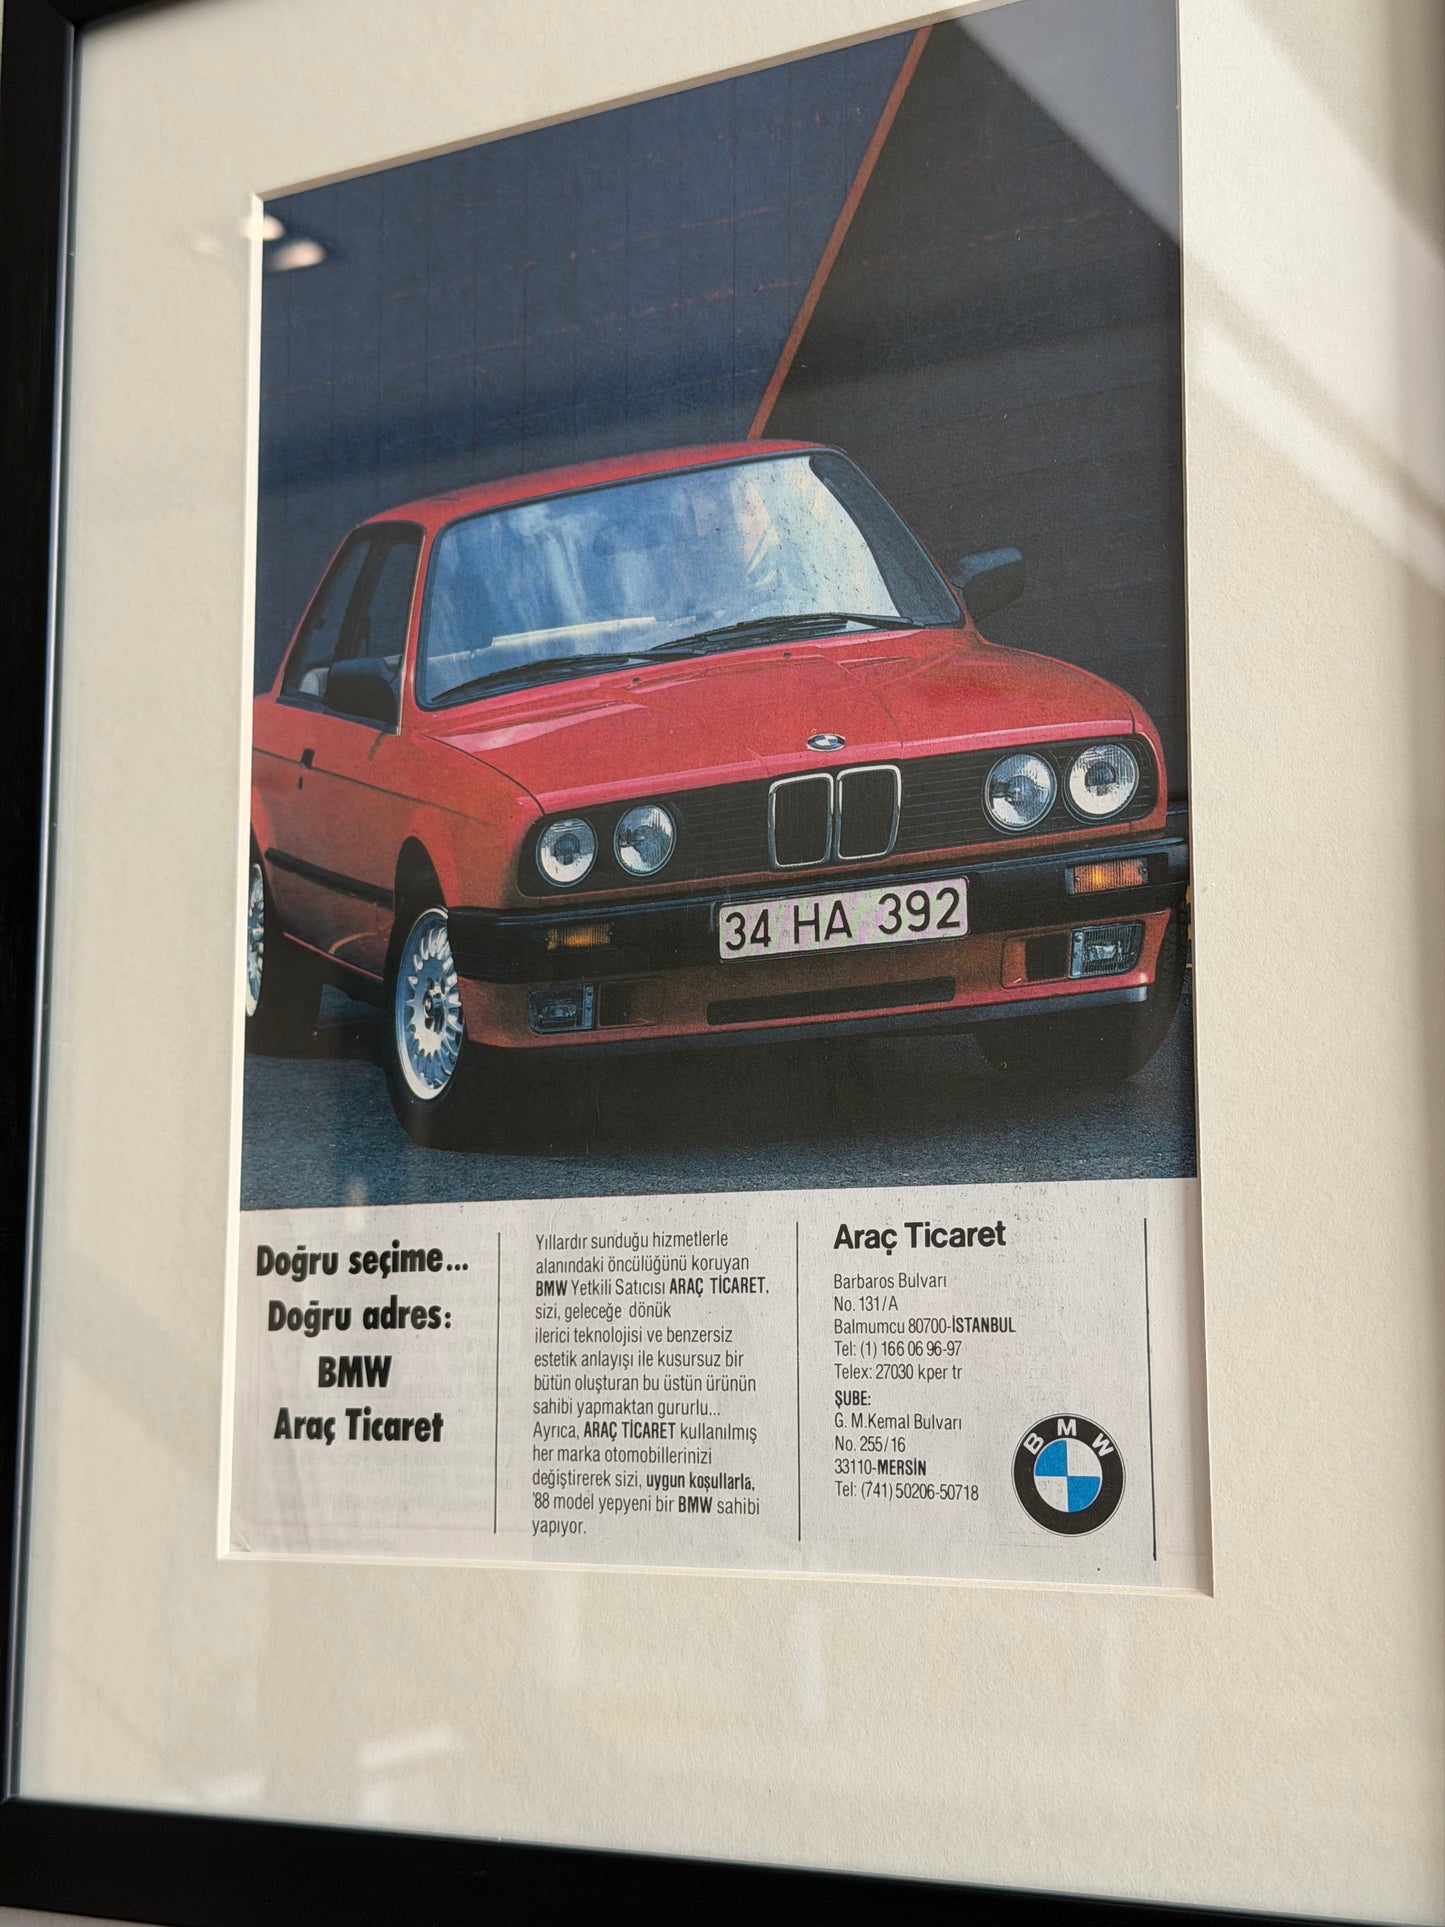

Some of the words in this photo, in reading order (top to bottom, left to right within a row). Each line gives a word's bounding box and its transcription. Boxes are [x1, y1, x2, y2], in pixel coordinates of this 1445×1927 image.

[724, 908, 772, 951] 34
[793, 901, 852, 943] HA
[878, 886, 961, 935] 392
[536, 1234, 587, 1250] Yıllardır
[591, 1233, 649, 1251] sunduğu
[652, 1230, 728, 1248] hizmetlerle
[833, 1224, 898, 1256] Araç
[904, 1220, 1007, 1248] Ticaret
[256, 1245, 339, 1282] Doğru
[348, 1239, 469, 1279] seçime...
[536, 1257, 604, 1274] alanındaki
[608, 1255, 687, 1275] öncülüğünü
[692, 1256, 749, 1274] koruyan
[536, 1280, 568, 1296] BMW
[571, 1279, 612, 1296] Yetkili
[615, 1279, 665, 1295] Satıcısı
[669, 1278, 704, 1297] ARAÇ
[710, 1275, 769, 1295] TİCARET,
[834, 1273, 894, 1289] Barbaros
[898, 1272, 947, 1288] Bulvarı
[535, 1304, 560, 1320] sizi,
[564, 1303, 622, 1322] geleceğe
[629, 1301, 671, 1318] dönük
[834, 1296, 856, 1311] No.
[268, 1300, 351, 1337] Doğru
[362, 1294, 452, 1329] adres:
[834, 1318, 905, 1334] Balmumcu
[908, 1315, 1017, 1333] 80700-İSTANBUL
[535, 1326, 570, 1344] ilerici
[574, 1326, 642, 1346] teknolojisi
[647, 1330, 663, 1343] ve
[666, 1326, 733, 1343] benzersiz
[834, 1341, 857, 1356] Tel:
[860, 1341, 877, 1358] (1)
[881, 1341, 904, 1356] 166
[907, 1341, 923, 1356] 06
[926, 1340, 962, 1356] 96-97
[534, 1350, 577, 1367] estetik
[581, 1350, 634, 1370] anlayışı
[638, 1350, 654, 1366] ile
[658, 1350, 721, 1367] kusursuz
[725, 1350, 744, 1367] bir
[318, 1355, 392, 1387] BMW
[834, 1364, 873, 1379] Telex:
[875, 1363, 914, 1379] 27030
[918, 1363, 948, 1383] kper
[952, 1365, 963, 1379] tr
[534, 1374, 571, 1391] bütün
[575, 1374, 639, 1394] oluşturan
[643, 1374, 659, 1391] bu
[664, 1375, 702, 1391] üstün
[706, 1375, 756, 1392] ürünün
[533, 1398, 573, 1415] sahibi
[577, 1398, 654, 1417] yapmaktan
[657, 1399, 721, 1418] gururlu...
[835, 1390, 871, 1409] ŞUBE:
[274, 1407, 336, 1445] Araç
[345, 1406, 444, 1442] Ticaret
[533, 1422, 580, 1440] Ayrıca,
[584, 1421, 617, 1441] ARAÇ
[622, 1418, 676, 1439] TİCARET
[680, 1423, 757, 1444] kullanılmış
[914, 1413, 962, 1430] Bulvarı
[835, 1435, 856, 1451] No.
[1023, 1418, 1114, 1457] BMW
[532, 1445, 553, 1461] her
[557, 1445, 601, 1462] marka
[604, 1447, 712, 1464] otomobillerinizi
[835, 1458, 927, 1476] 33110-MERSİN
[532, 1469, 611, 1489] değiştirerek
[615, 1470, 642, 1489] sizi,
[646, 1474, 686, 1491] uygun
[689, 1472, 756, 1492] koşullarla,
[835, 1481, 857, 1497] Tel:
[861, 1480, 893, 1501] (741)
[896, 1483, 979, 1501] 50206-50718
[553, 1492, 594, 1510] model
[599, 1494, 652, 1515] yepyeni
[655, 1495, 674, 1513] bir
[678, 1496, 713, 1513] BMW
[717, 1497, 760, 1515] sahibi
[531, 1518, 587, 1537] yapıyor.
